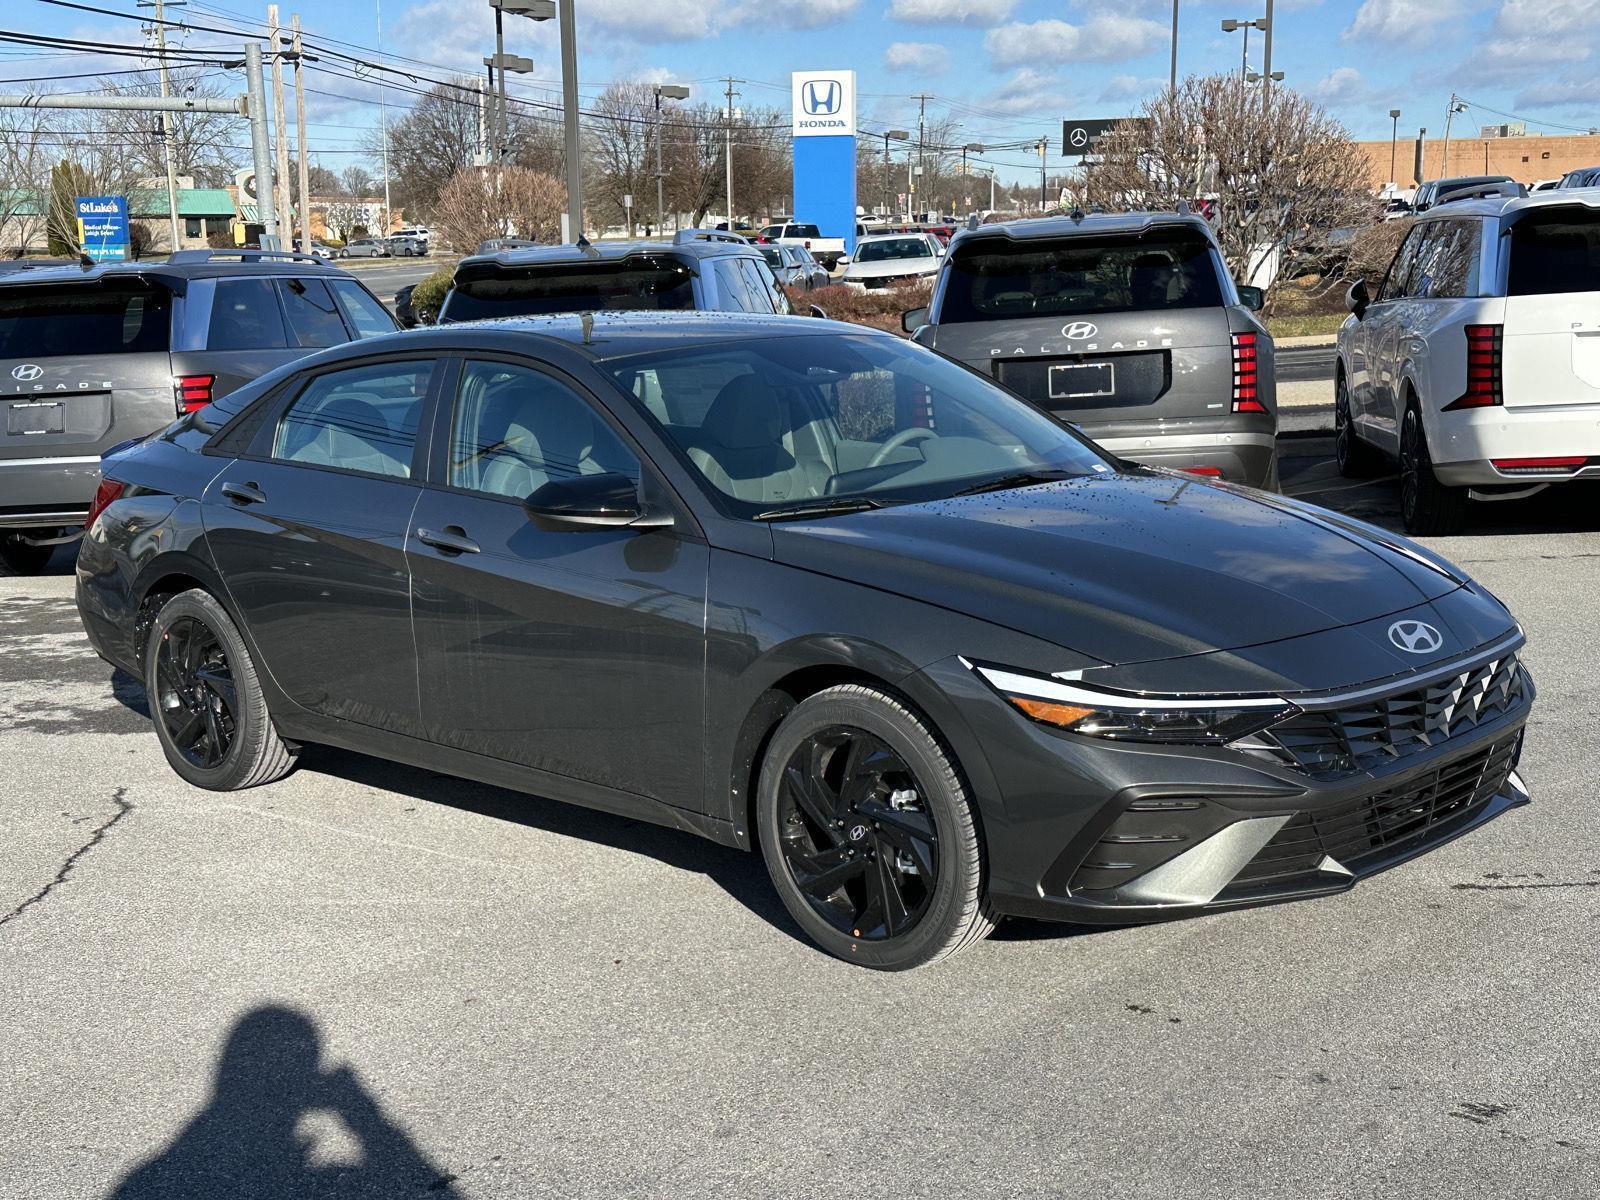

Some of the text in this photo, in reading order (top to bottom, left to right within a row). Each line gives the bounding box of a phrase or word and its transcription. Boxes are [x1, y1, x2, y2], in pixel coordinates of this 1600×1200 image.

[799, 120, 846, 128] HONDA
[991, 338, 1173, 355] PALISADE
[0, 381, 113, 392] ISADE
